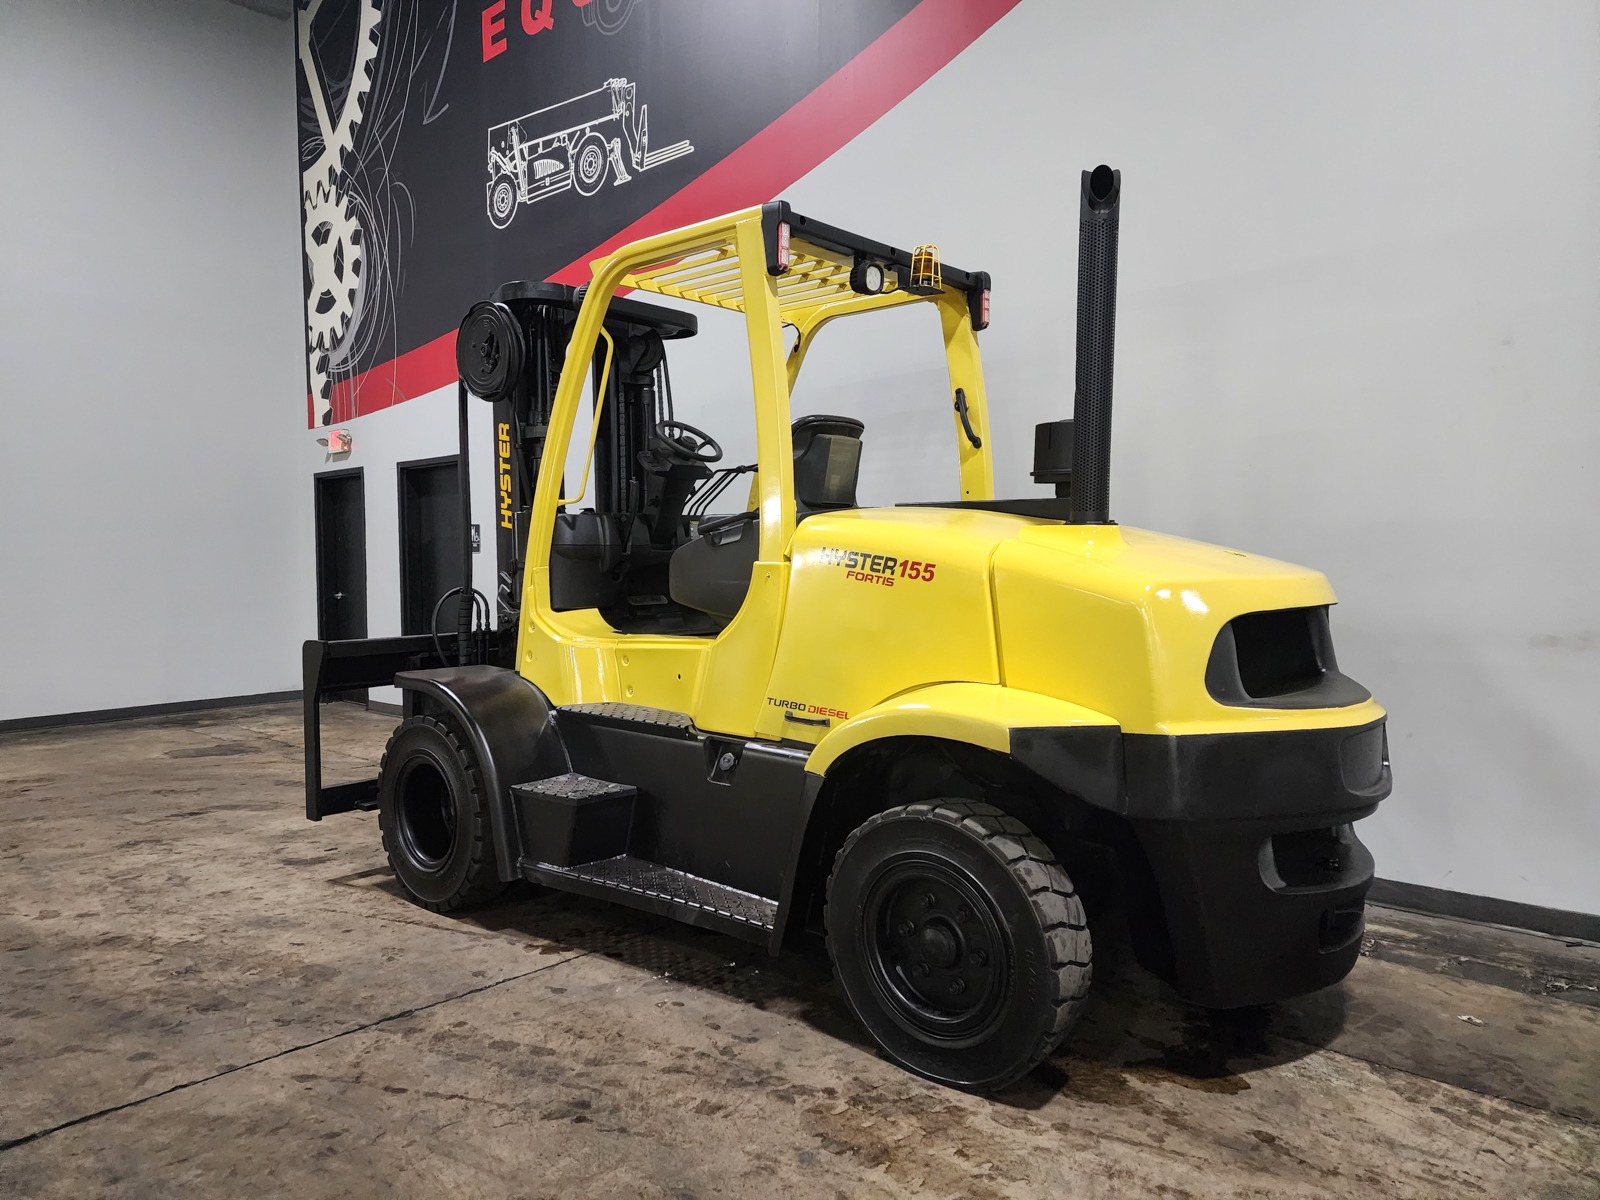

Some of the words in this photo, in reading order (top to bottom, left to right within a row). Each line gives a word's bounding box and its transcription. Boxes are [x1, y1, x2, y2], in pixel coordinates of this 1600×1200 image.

[481, 0, 592, 63] EQ
[498, 422, 513, 529] HYSTER
[846, 570, 895, 587] FORTIS
[899, 559, 937, 582] 155
[767, 697, 806, 712] TURBO
[807, 704, 850, 720] DIESEL
